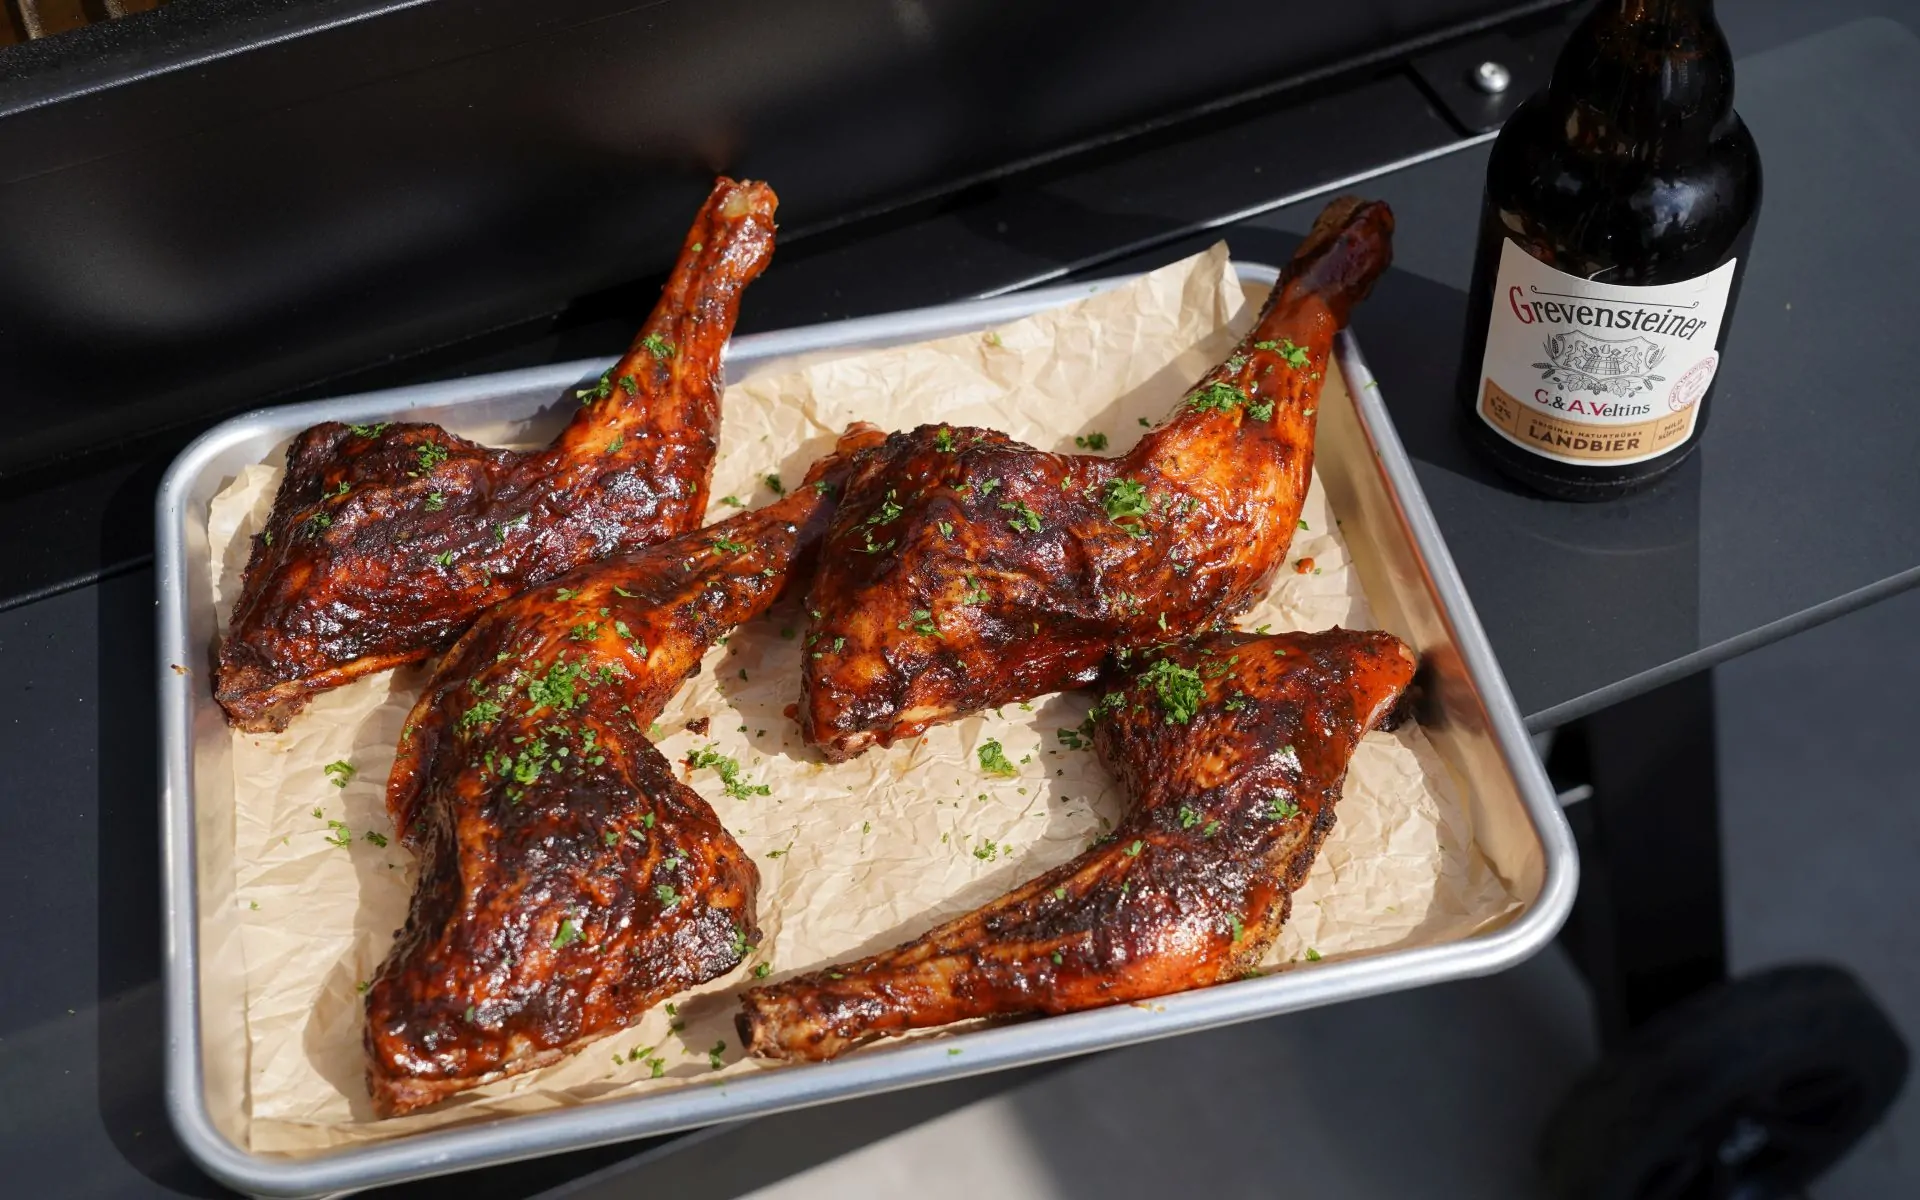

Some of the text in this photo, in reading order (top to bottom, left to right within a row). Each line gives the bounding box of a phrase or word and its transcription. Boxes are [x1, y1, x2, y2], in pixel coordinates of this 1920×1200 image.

[1509, 286, 1707, 341] Grevensteiner
[1528, 425, 1640, 452] LANDBIER
[1532, 418, 1574, 436] ORIGINAL
